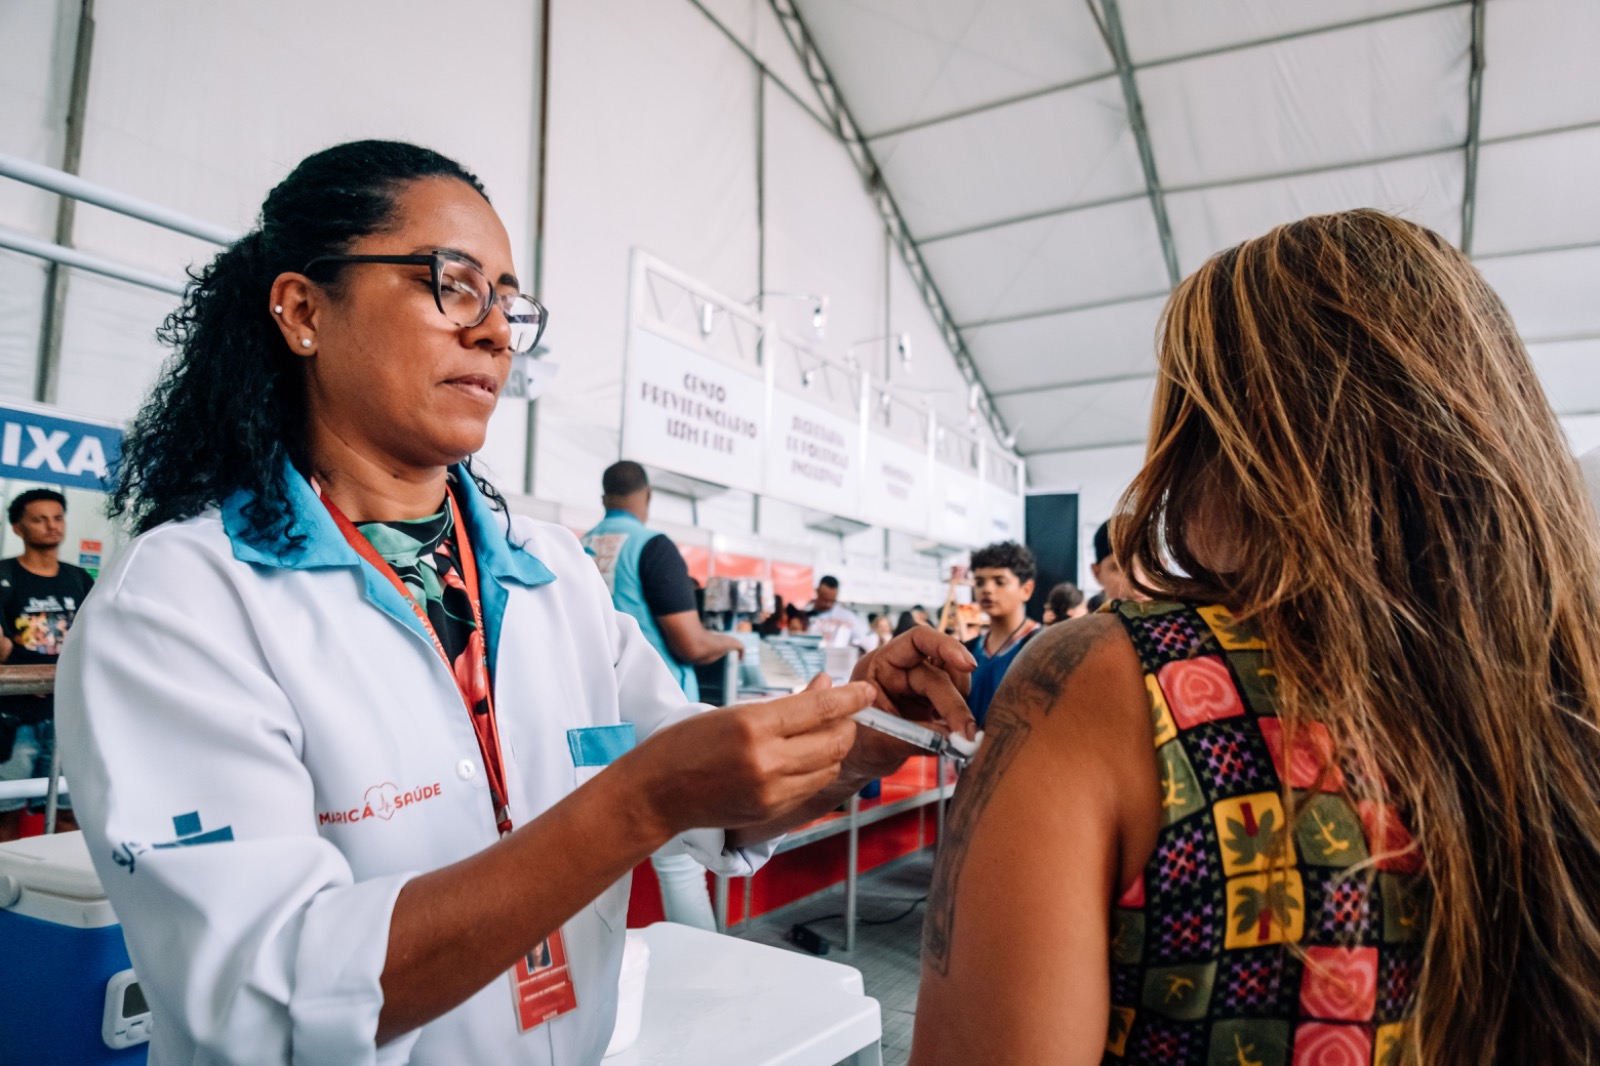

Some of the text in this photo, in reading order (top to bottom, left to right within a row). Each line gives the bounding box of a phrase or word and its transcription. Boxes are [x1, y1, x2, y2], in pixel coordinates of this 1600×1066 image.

[683, 372, 727, 404] CENSO
[319, 783, 441, 825] MARICÁ SAÚDE
